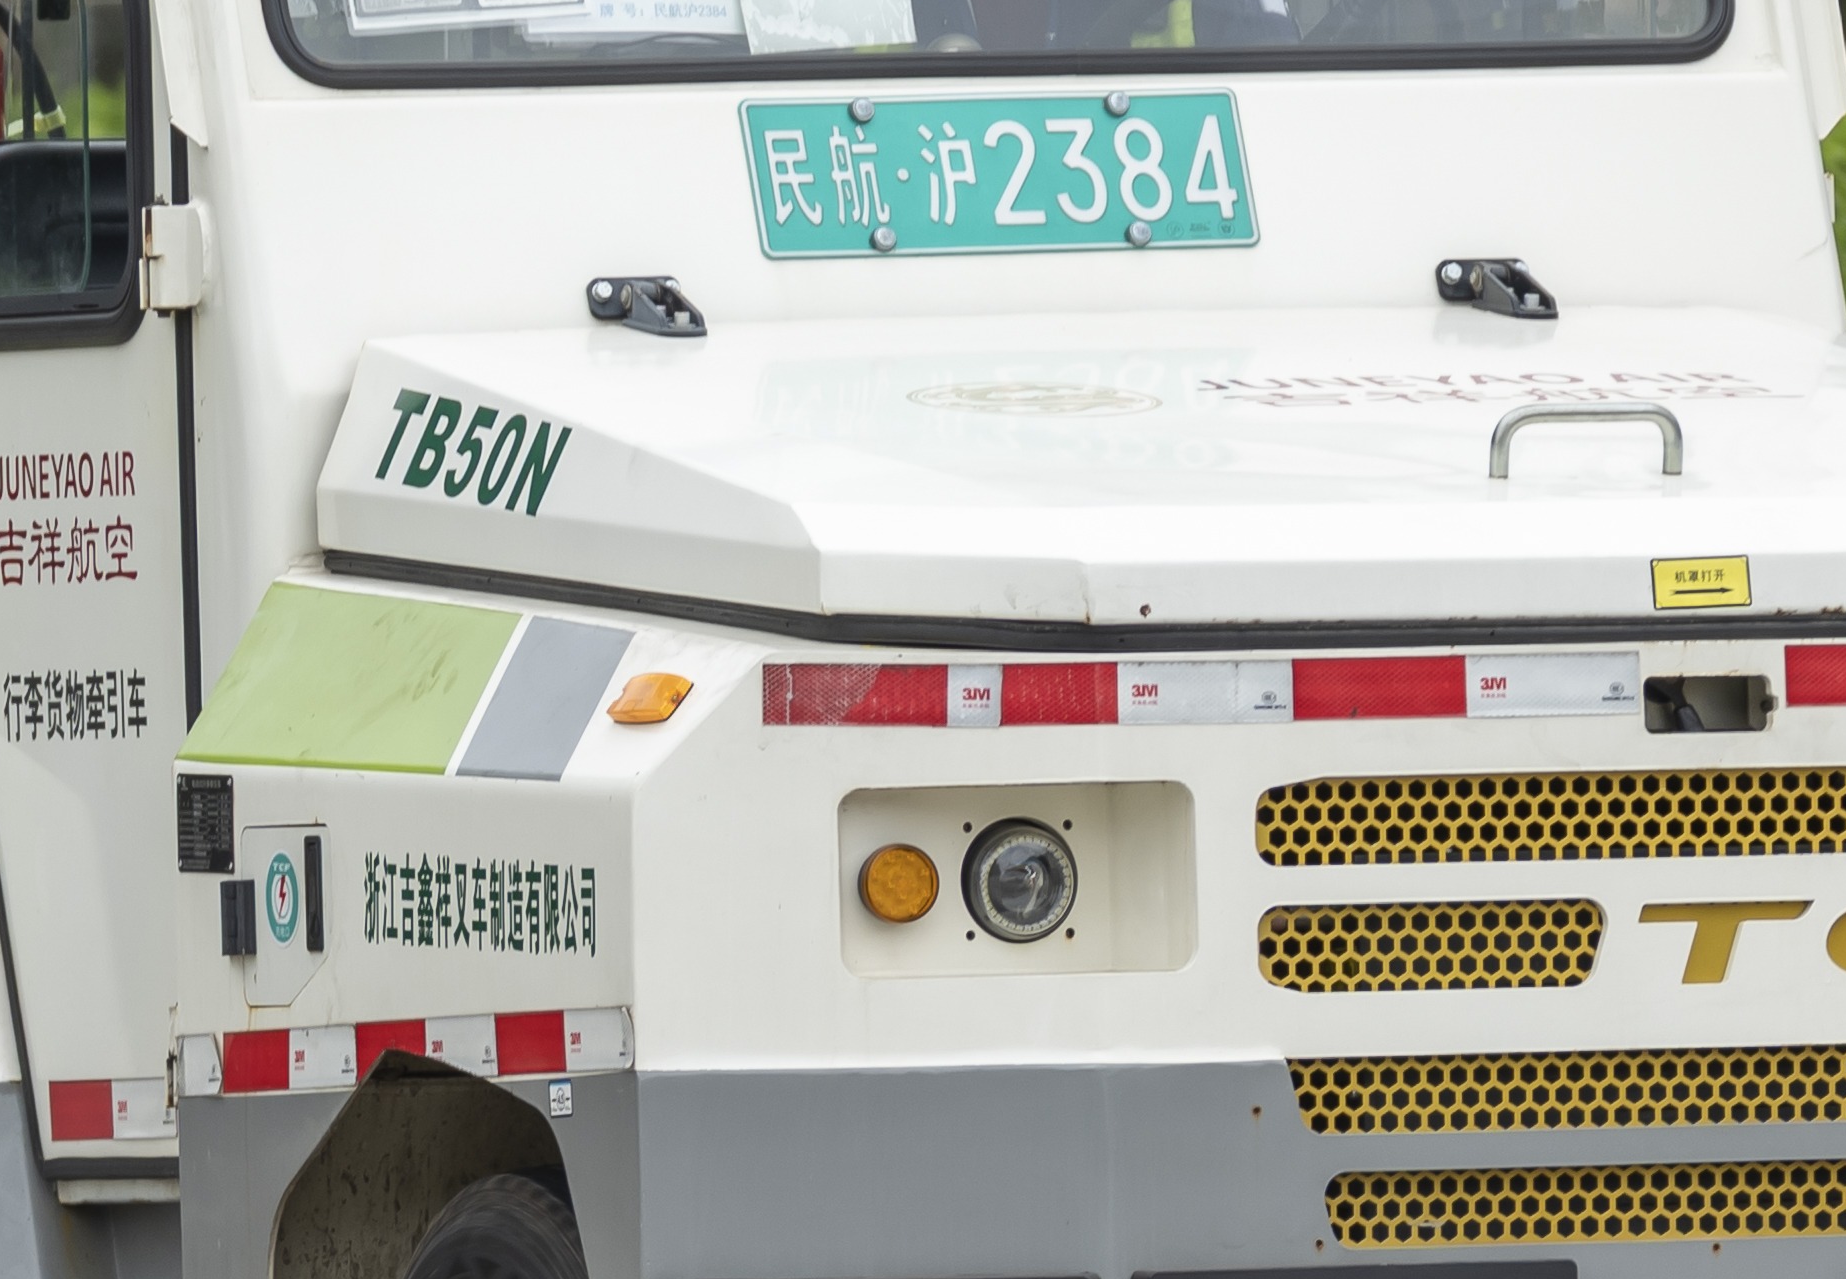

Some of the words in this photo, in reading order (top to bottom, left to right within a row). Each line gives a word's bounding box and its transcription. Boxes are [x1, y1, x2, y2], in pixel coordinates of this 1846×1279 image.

[375, 388, 573, 517] TB50N
[100, 451, 136, 497] AIR
[1675, 568, 1724, 583] 机罩打开
[962, 687, 991, 701] 3M
[1132, 683, 1159, 698] 3M
[1480, 677, 1507, 690] 3M
[3, 668, 148, 743] 行李货物牵引车
[364, 851, 596, 958] 浙江吉鑫祥叉车制造有限公司
